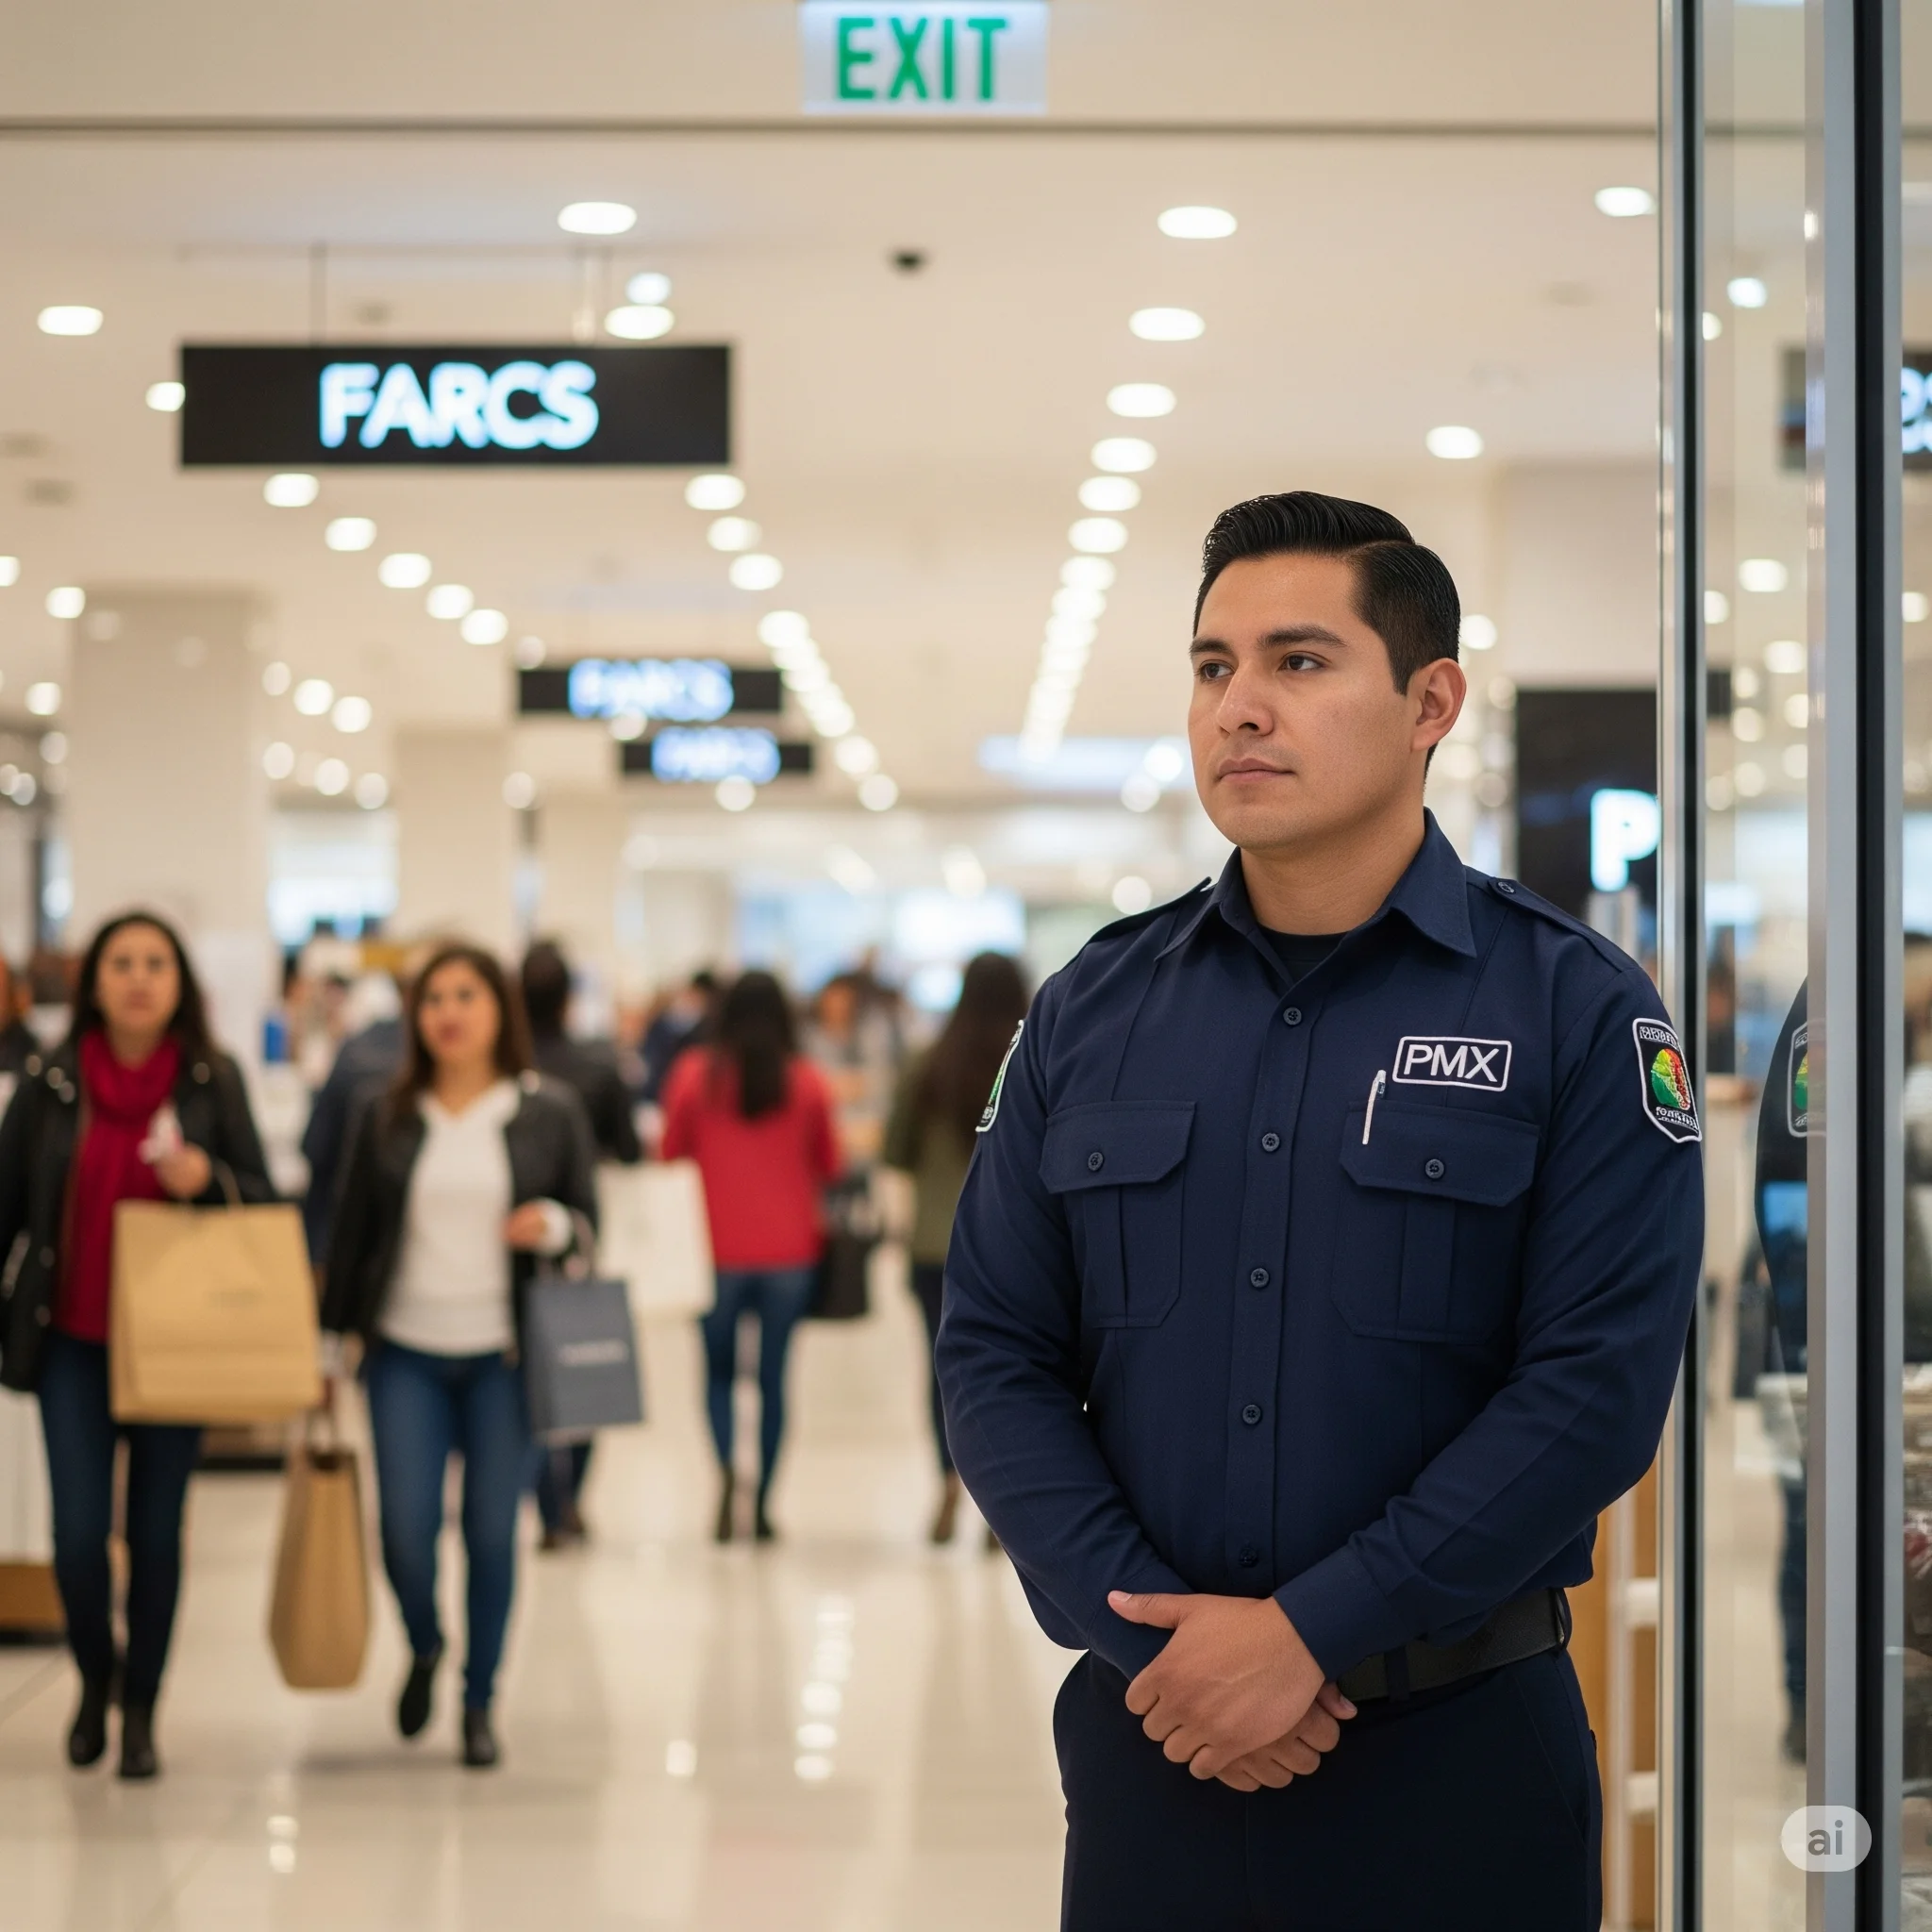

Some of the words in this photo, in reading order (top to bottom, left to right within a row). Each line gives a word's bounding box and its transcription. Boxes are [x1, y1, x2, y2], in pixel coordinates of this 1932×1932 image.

[836, 15, 1008, 101] EXIT
[319, 359, 600, 450] FARCS
[1402, 1043, 1500, 1083] PMX
